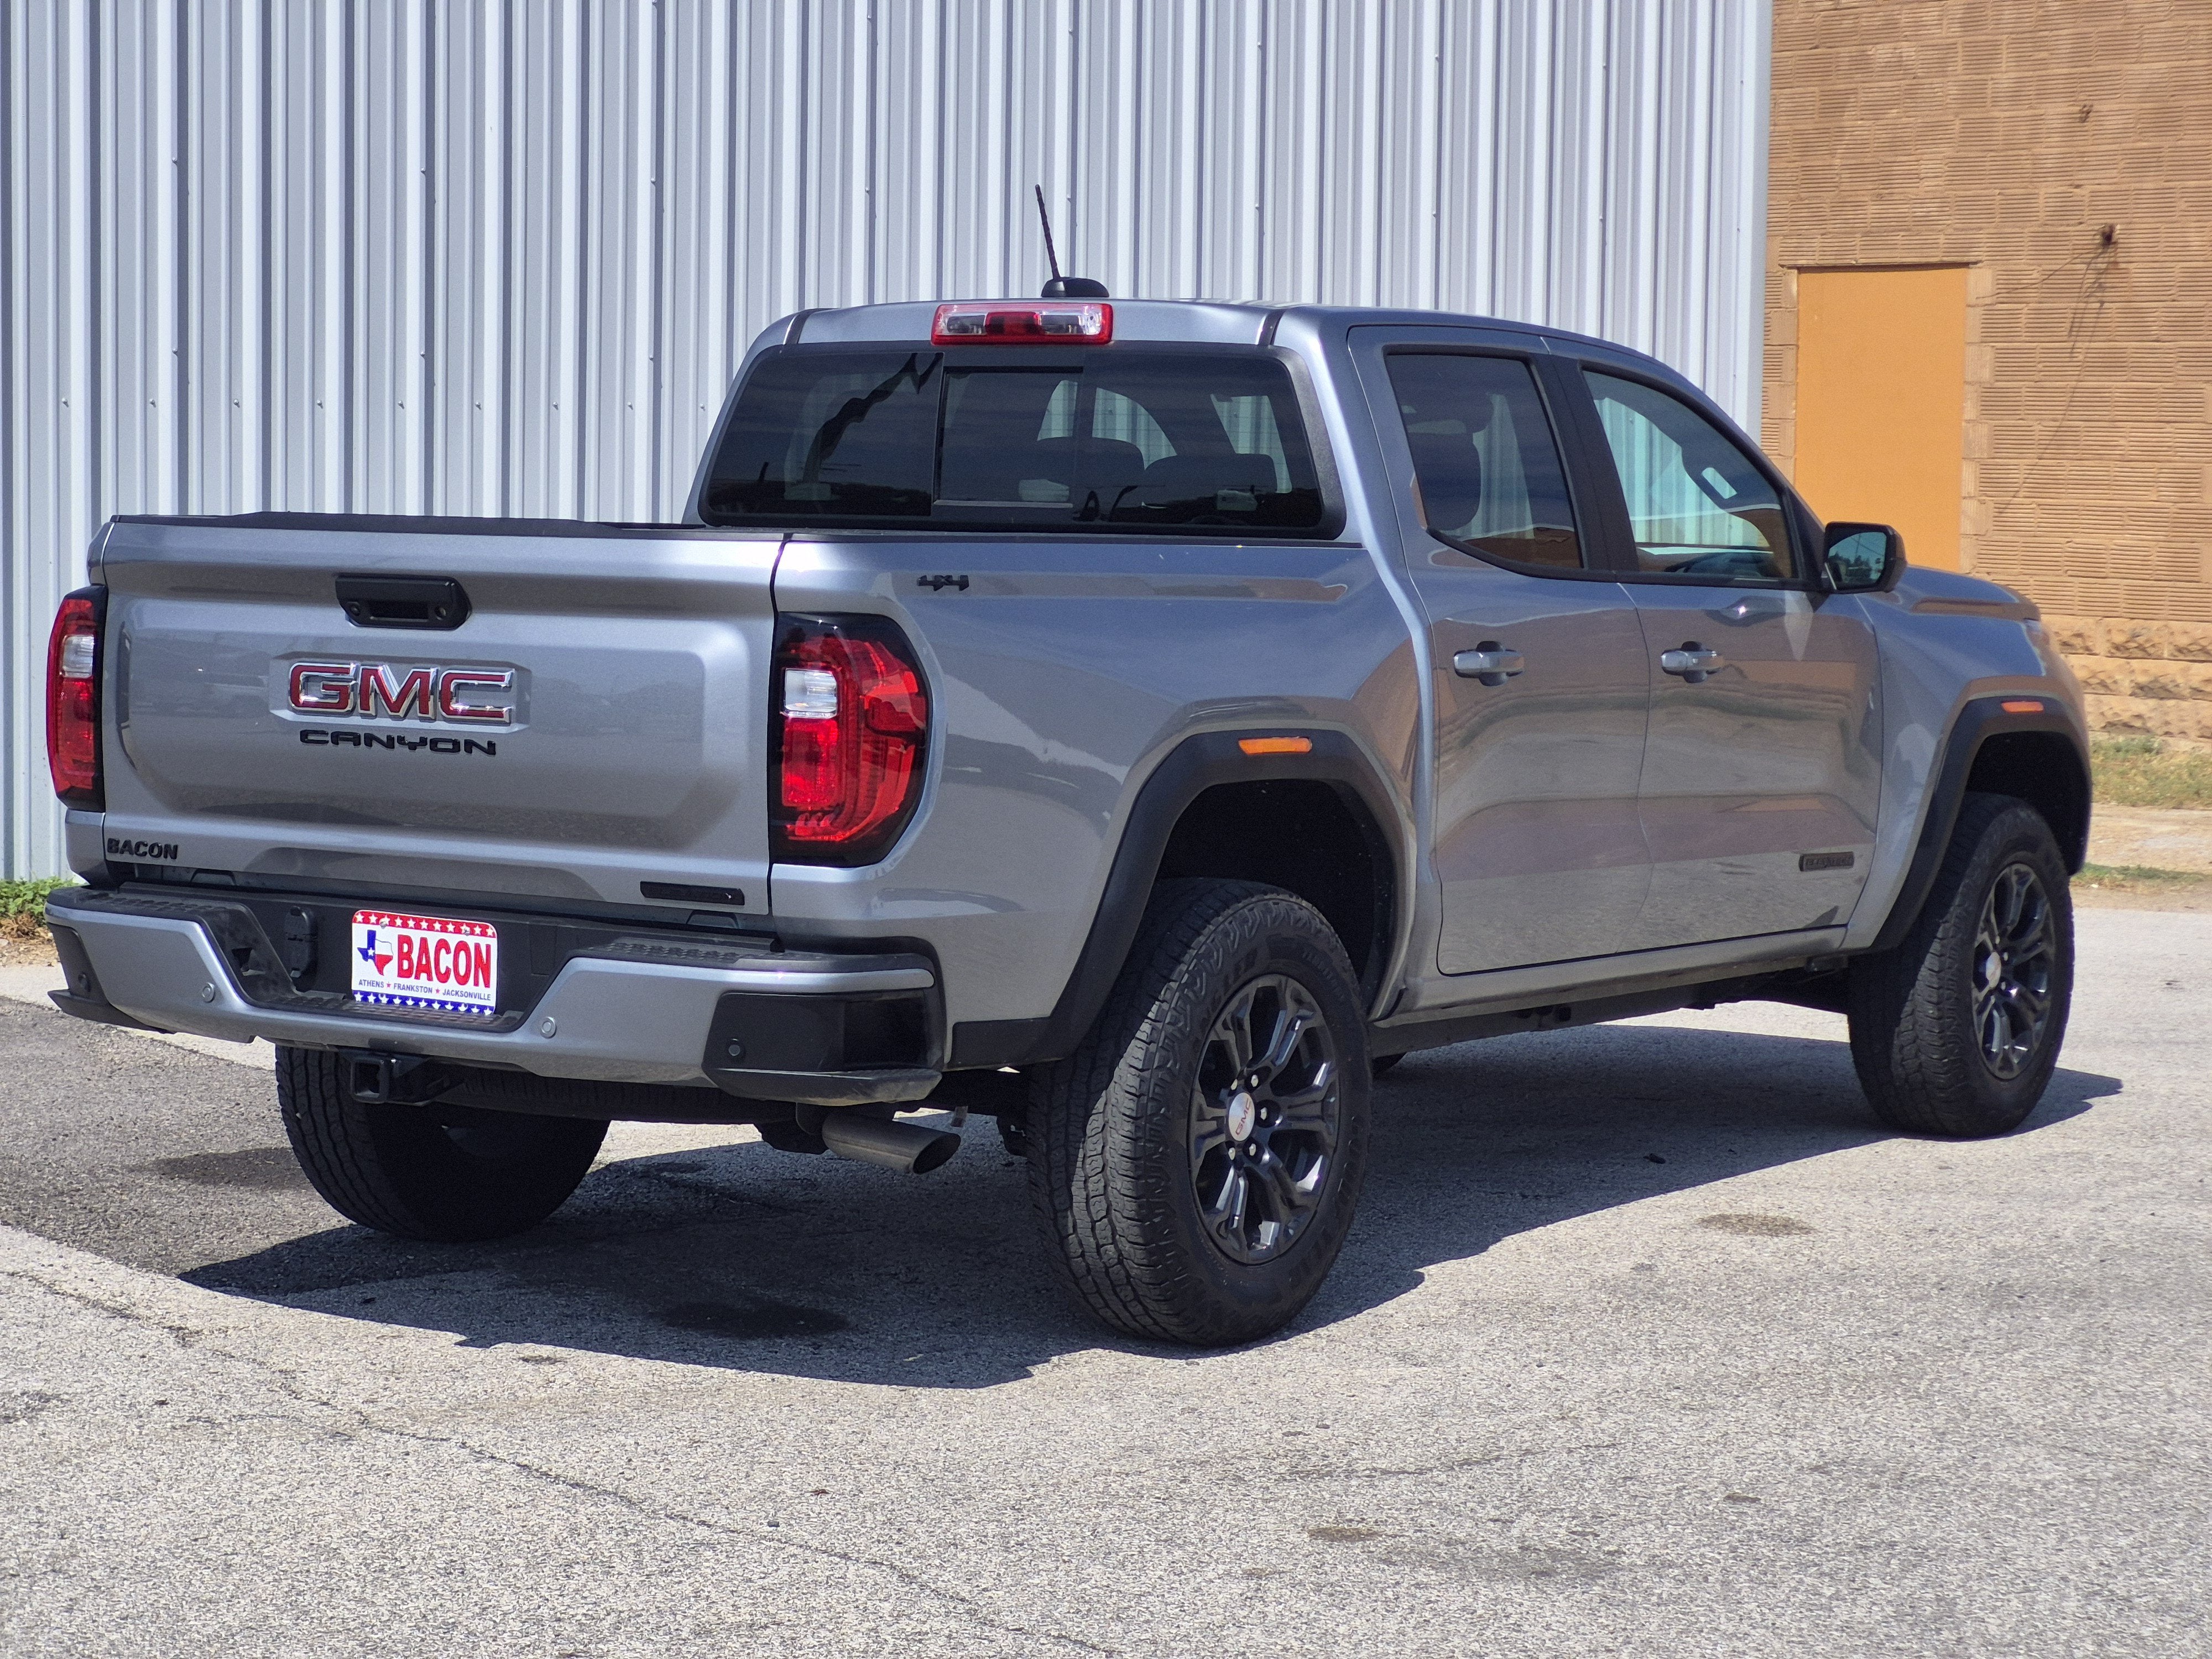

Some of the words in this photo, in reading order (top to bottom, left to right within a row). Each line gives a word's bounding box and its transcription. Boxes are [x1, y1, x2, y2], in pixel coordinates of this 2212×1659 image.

[288, 661, 516, 726] GMC
[299, 729, 497, 756] CANYON
[107, 838, 178, 860] BACON
[397, 934, 491, 988] BACON
[358, 979, 384, 989] ATHENS
[393, 983, 433, 994] FRANKSTON
[442, 989, 491, 1001] JACKSONVILLE
[1235, 1098, 1251, 1136] GMC
